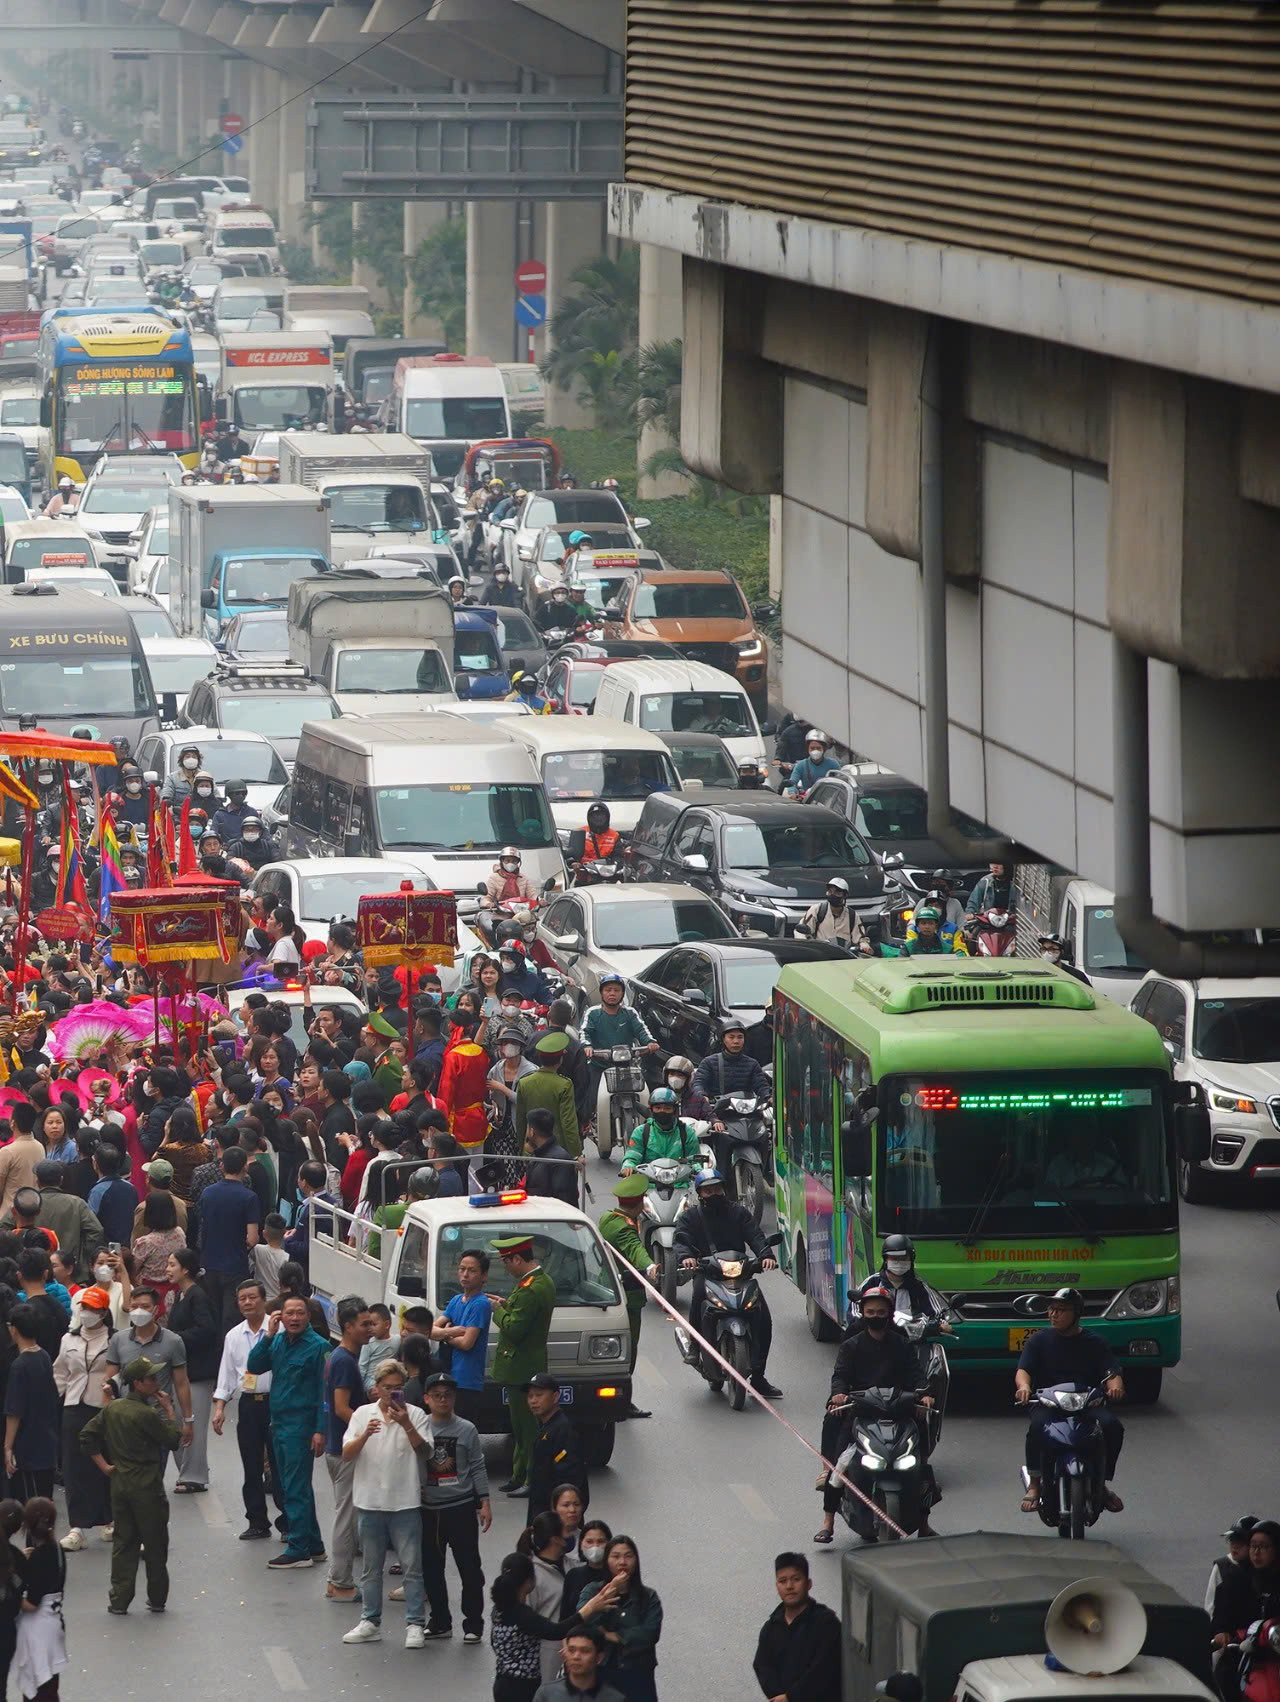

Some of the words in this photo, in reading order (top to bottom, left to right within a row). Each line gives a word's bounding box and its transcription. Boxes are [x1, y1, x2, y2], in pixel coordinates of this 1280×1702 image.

[268, 351, 309, 362] EXPRESS
[156, 367, 175, 378] LAM
[9, 636, 31, 648] XE
[35, 632, 69, 645] BƯU
[73, 630, 128, 646] CHÍNH
